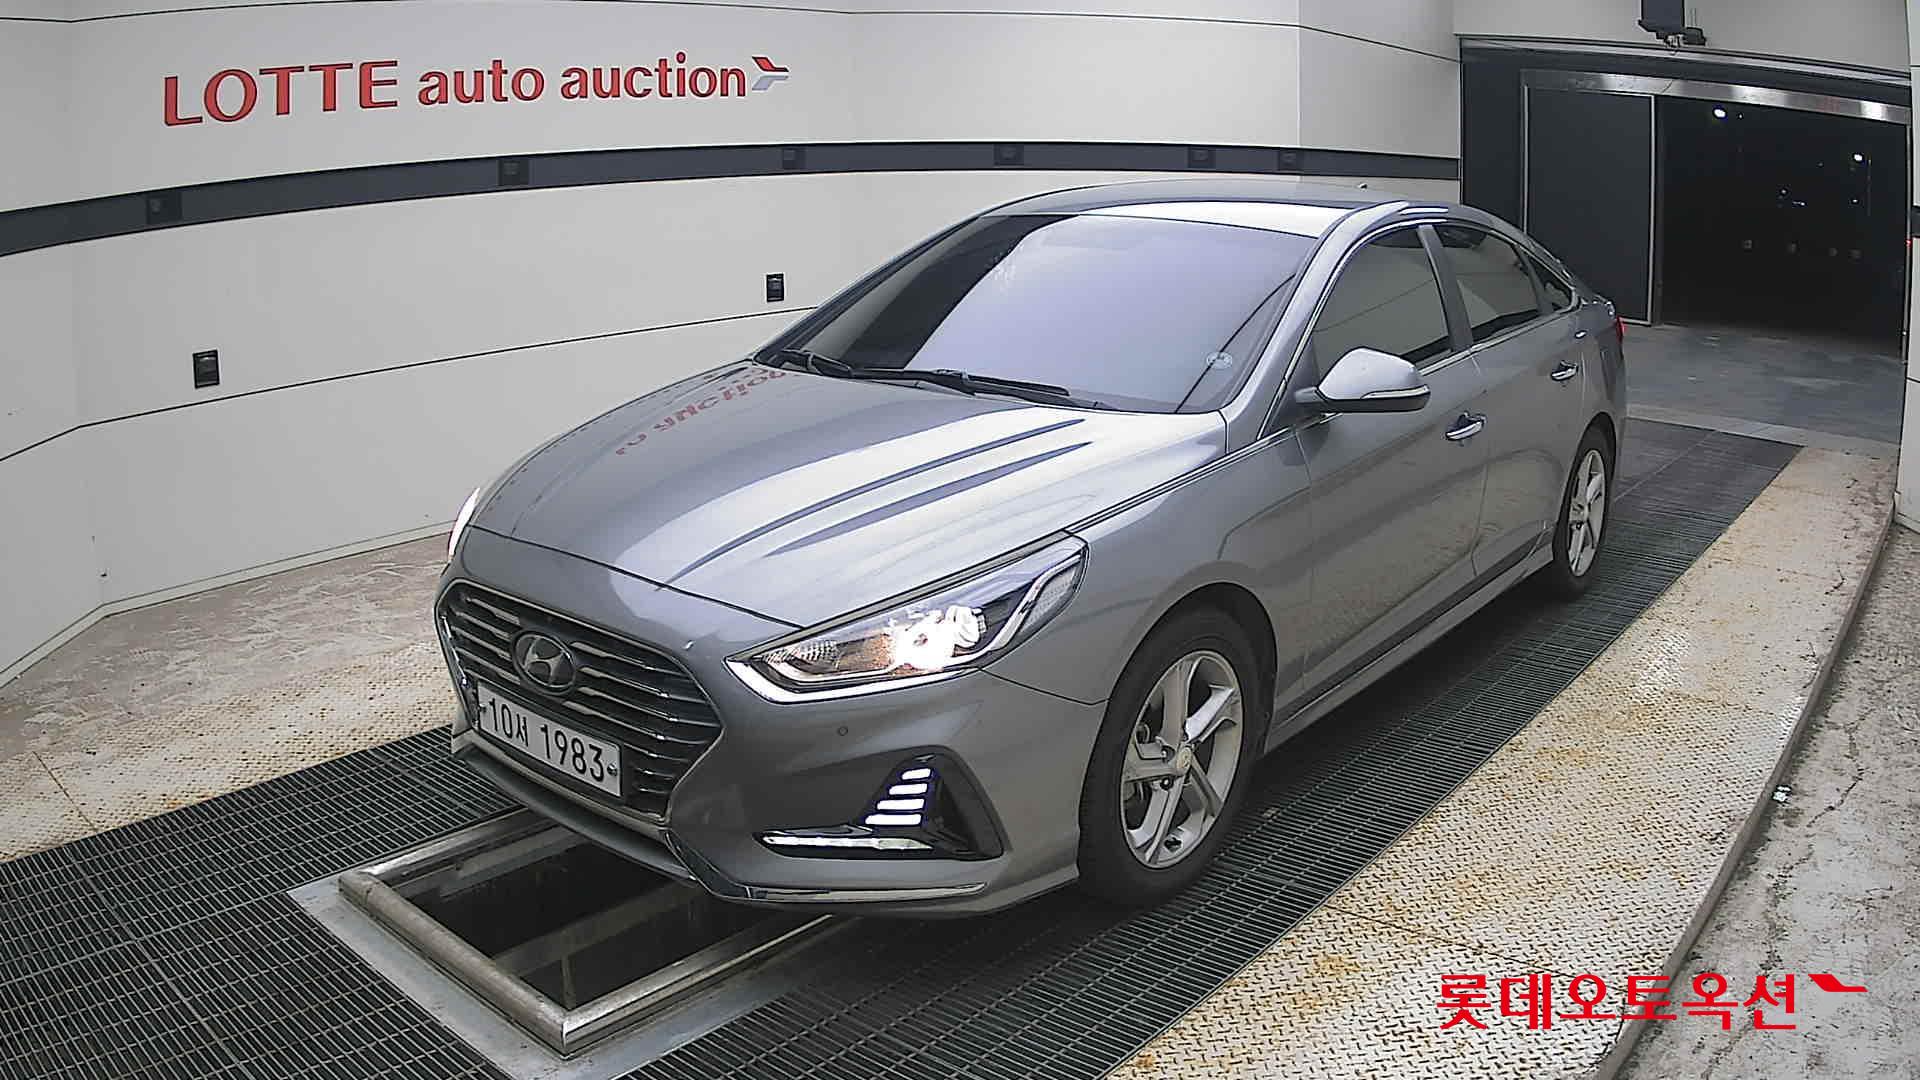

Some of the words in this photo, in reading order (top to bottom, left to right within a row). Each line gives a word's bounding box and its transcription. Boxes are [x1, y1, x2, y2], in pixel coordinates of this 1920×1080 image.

[163, 60, 399, 127] LOTTE
[418, 60, 546, 105] auto
[560, 52, 748, 99] auction
[488, 697, 529, 748] 10서
[540, 724, 605, 783] 1983
